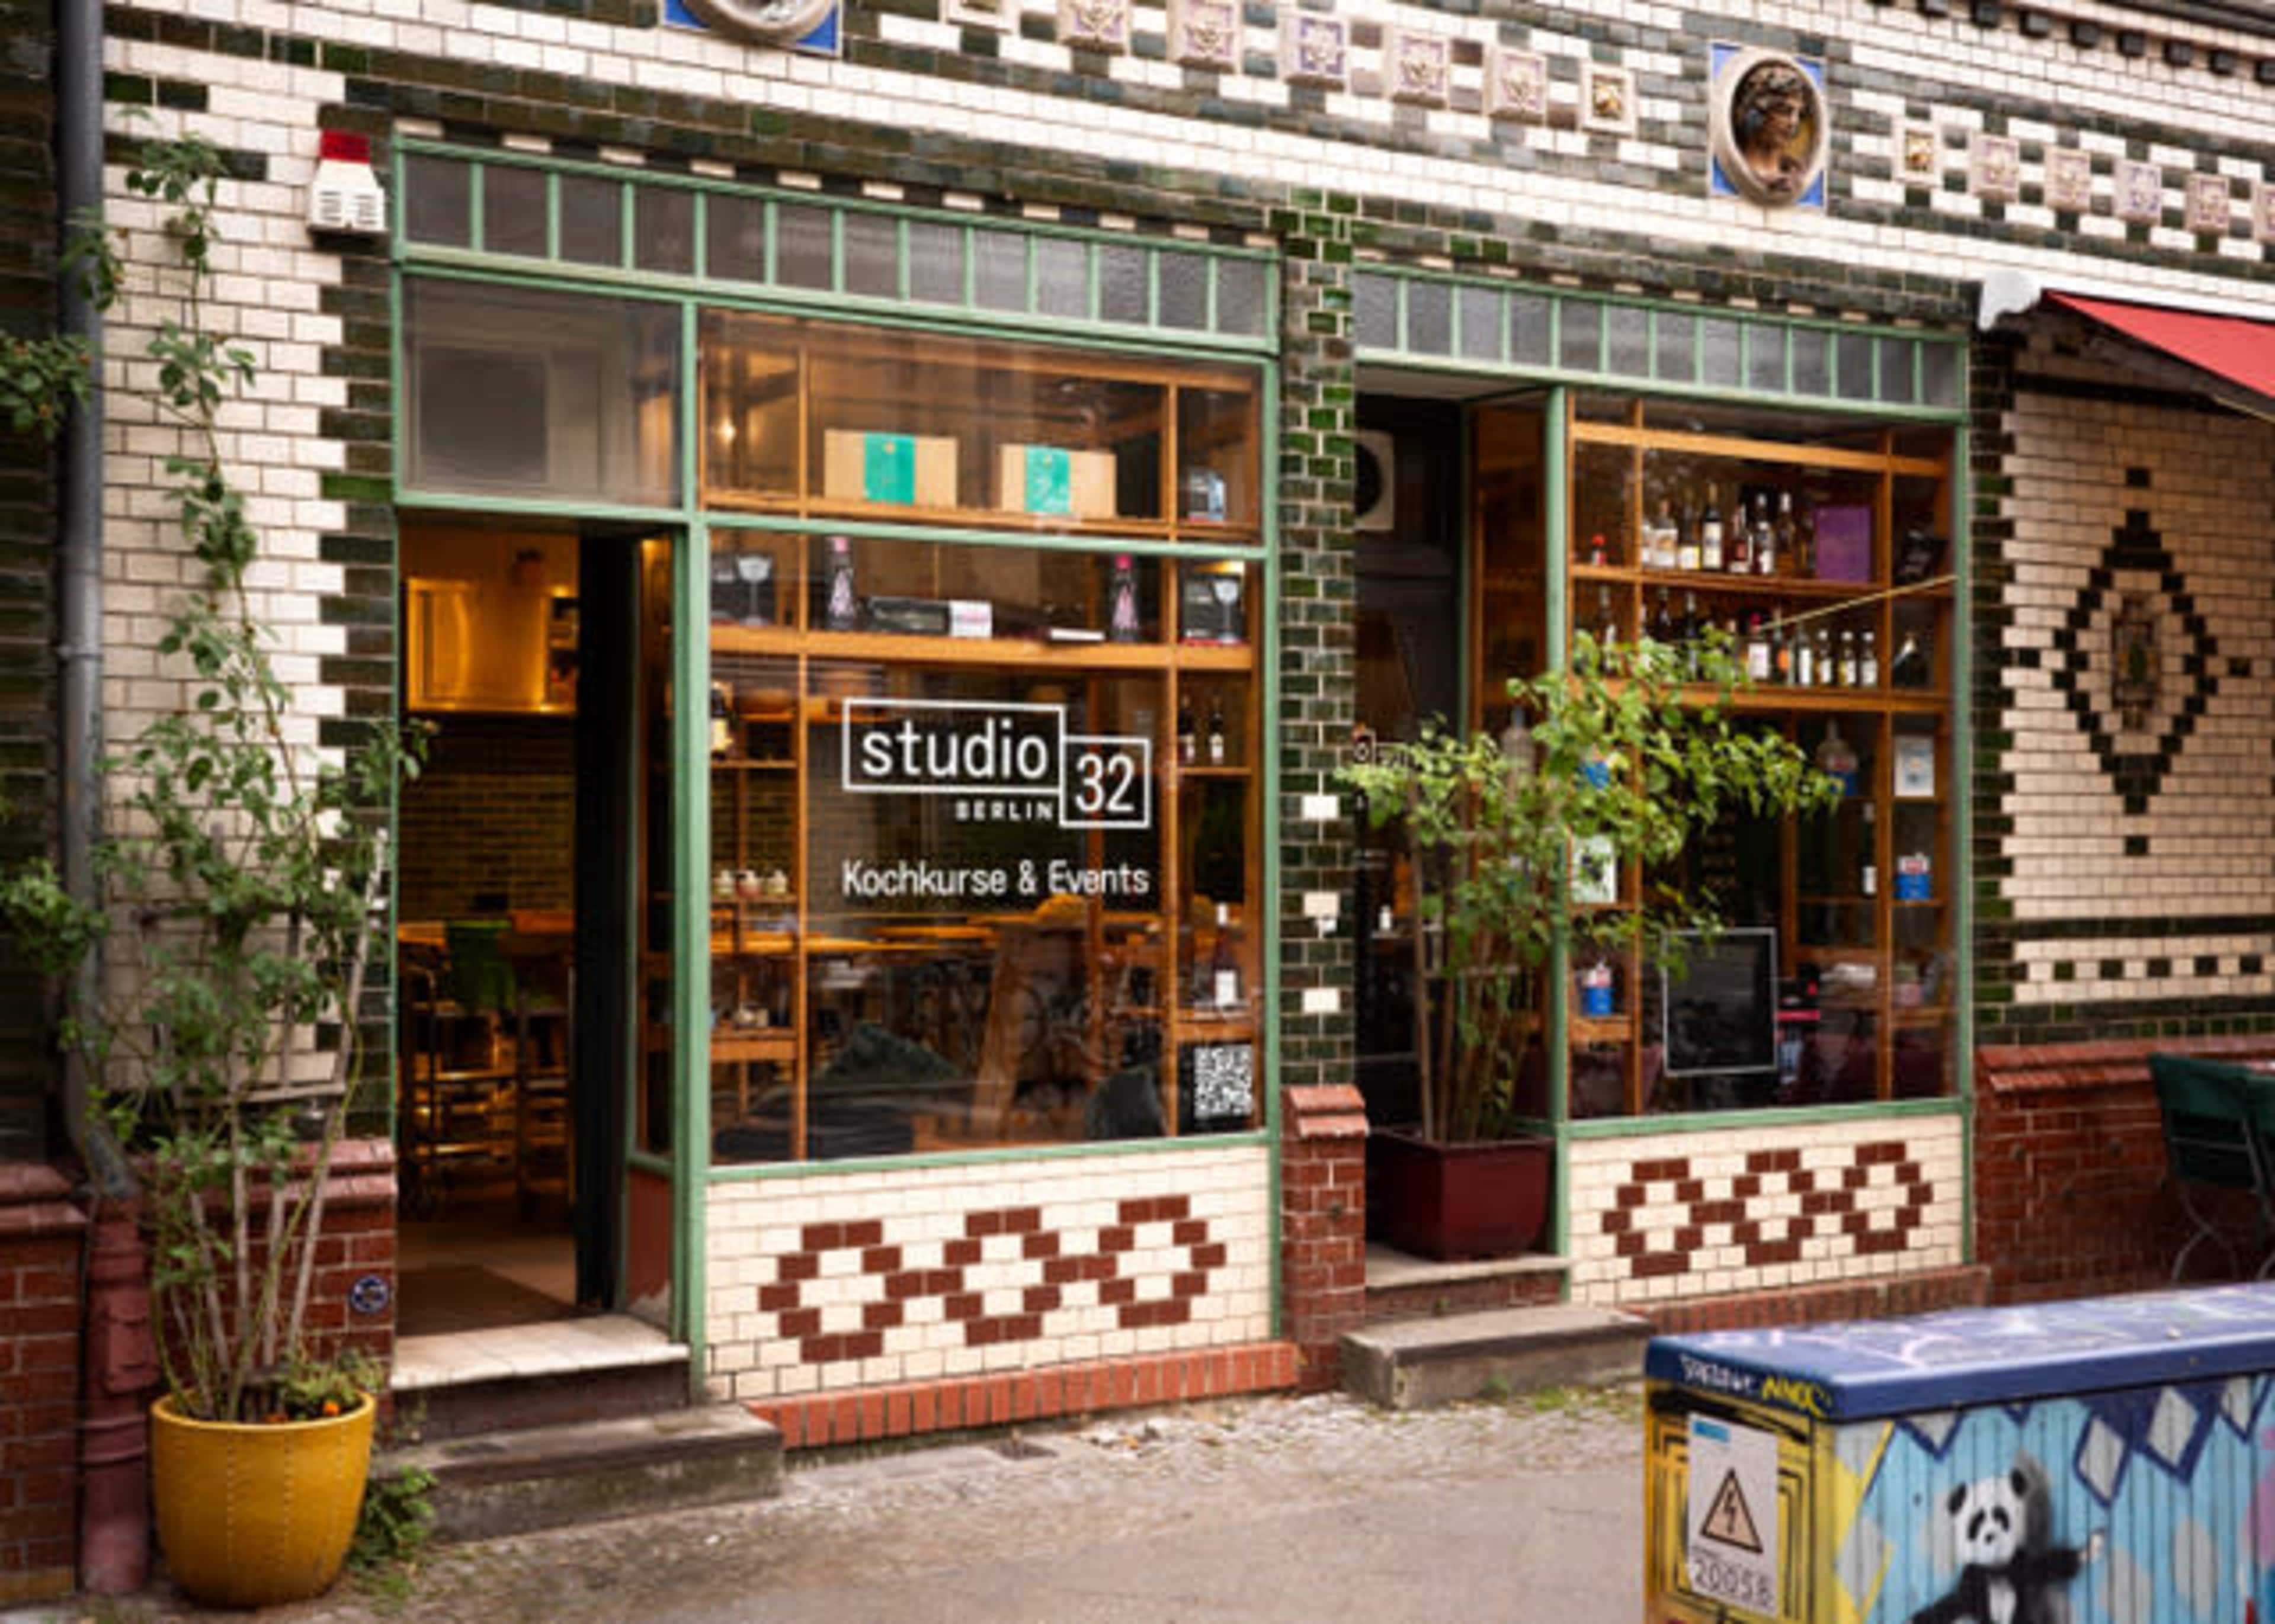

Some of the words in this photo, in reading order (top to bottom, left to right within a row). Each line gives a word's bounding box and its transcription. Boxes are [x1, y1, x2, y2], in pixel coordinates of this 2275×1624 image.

[861, 717, 1048, 779] studio
[1075, 753, 1135, 813] 32
[954, 800, 1053, 820] BERLIN
[842, 859, 1007, 897] Kochkurse
[1018, 860, 1037, 894] &
[1048, 859, 1150, 894] Events
